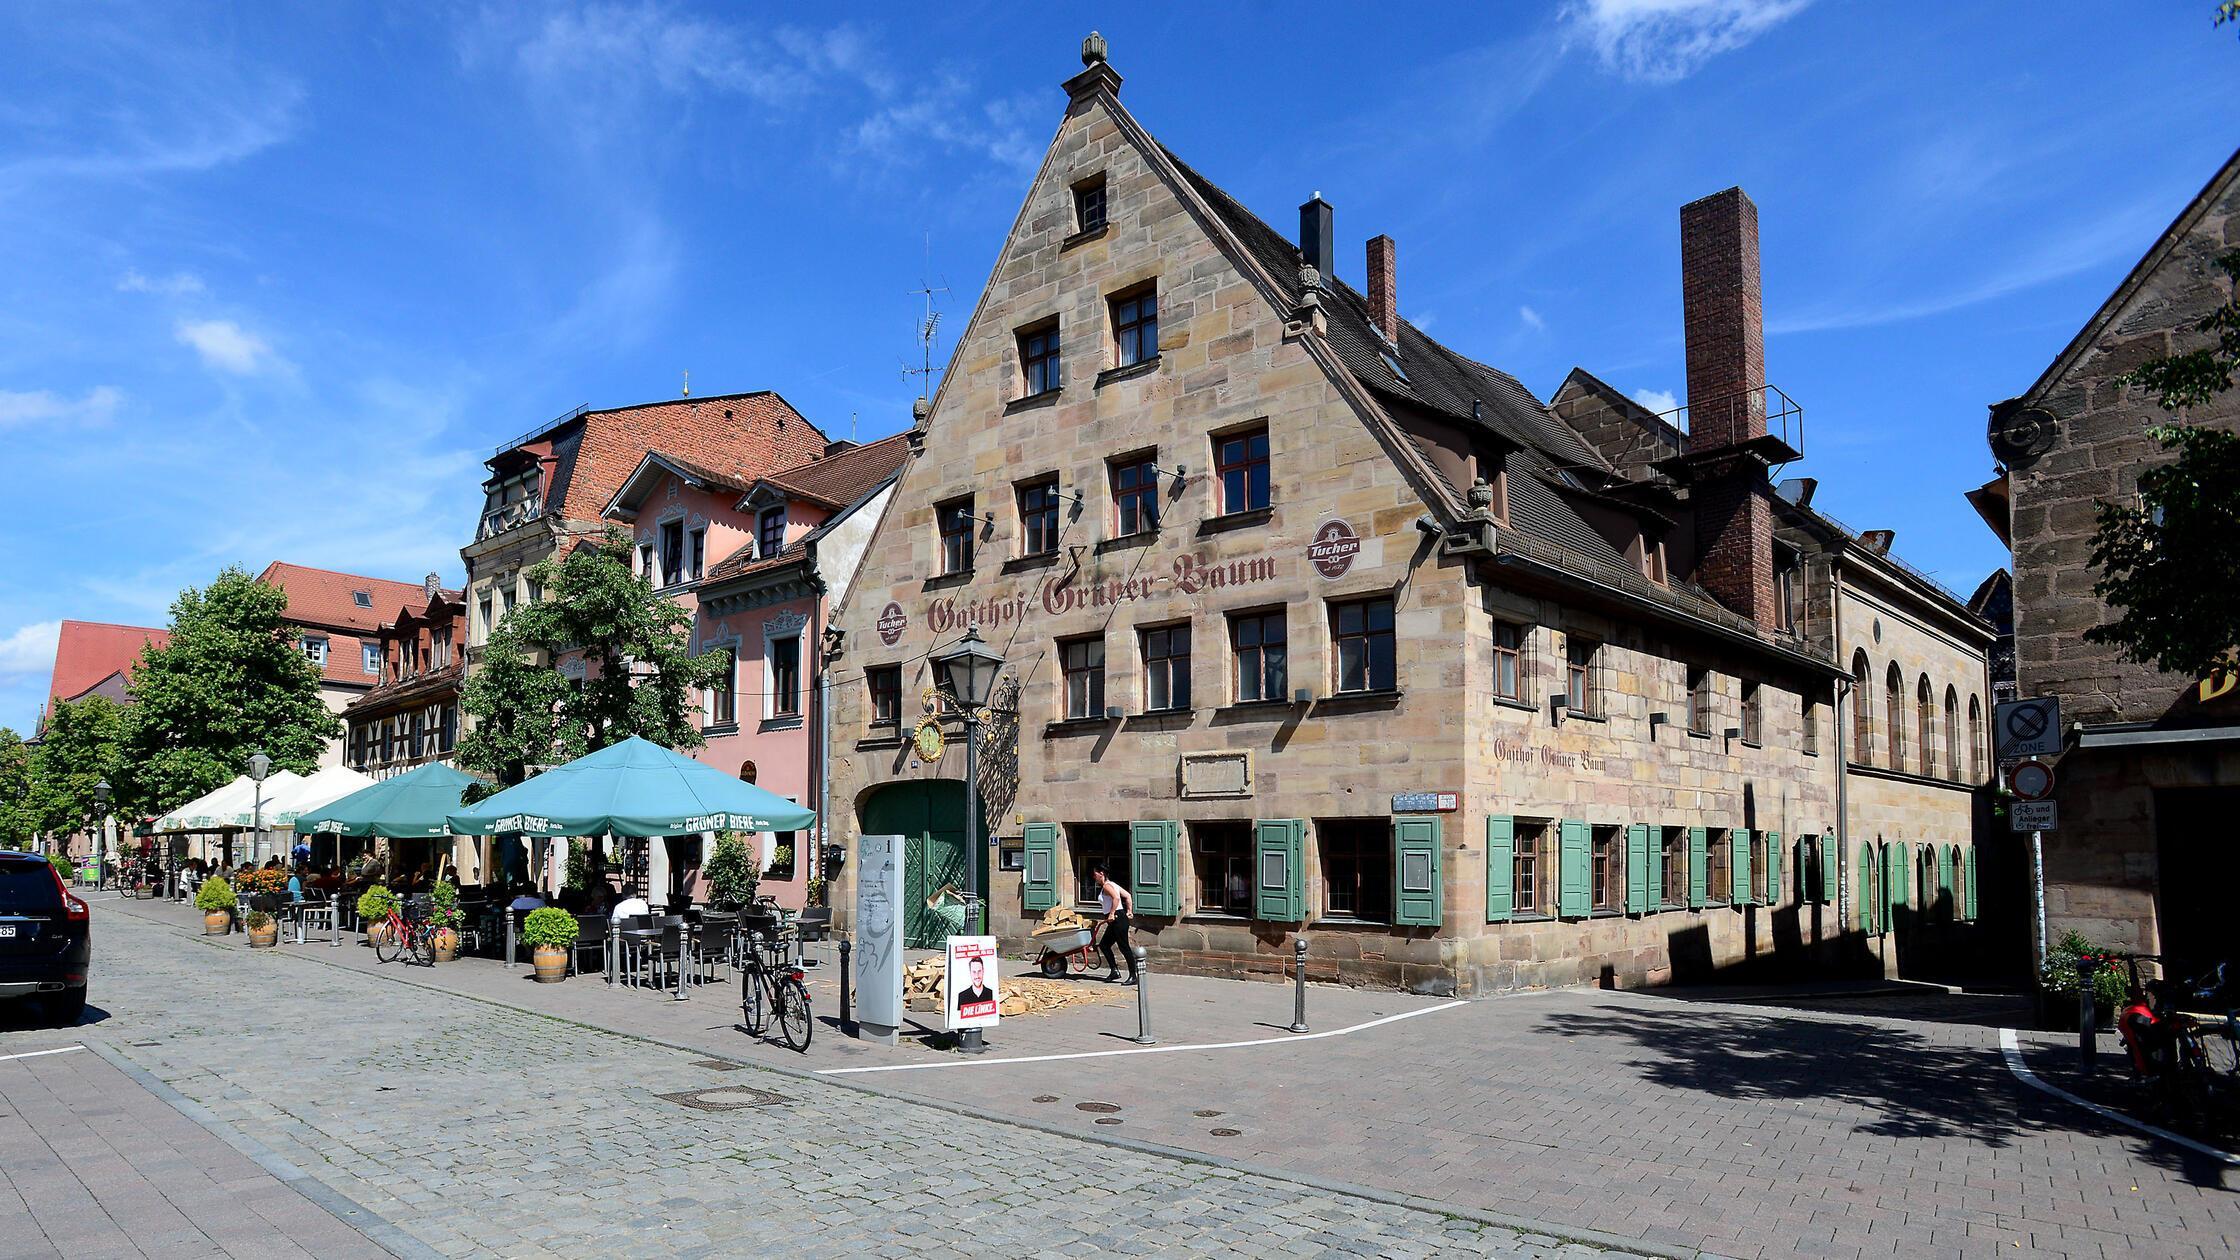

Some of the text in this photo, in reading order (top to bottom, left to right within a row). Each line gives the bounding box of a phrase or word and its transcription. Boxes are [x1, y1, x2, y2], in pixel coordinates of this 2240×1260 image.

[1311, 543, 1357, 557] Tucher
[1172, 552, 1277, 595] Baum
[879, 619, 905, 629] Tucher
[2014, 742, 2045, 753] ZONE
[1580, 750, 1606, 771] Baum
[2036, 805, 2050, 813] und
[524, 815, 549, 832] BIERE
[729, 814, 755, 829] BIERE
[2019, 815, 2050, 823] Anlieger
[963, 1006, 974, 1016] DIE
